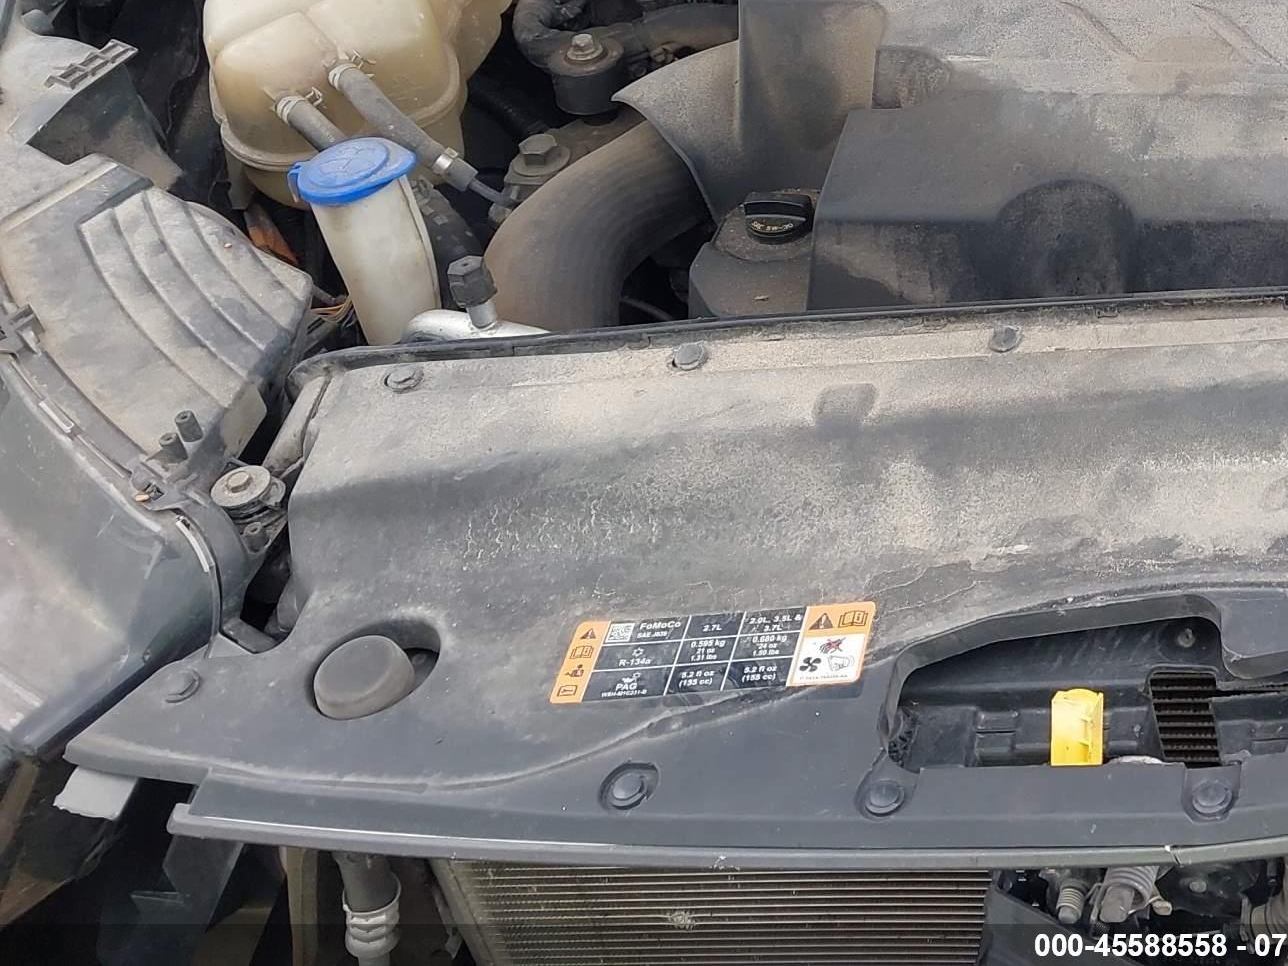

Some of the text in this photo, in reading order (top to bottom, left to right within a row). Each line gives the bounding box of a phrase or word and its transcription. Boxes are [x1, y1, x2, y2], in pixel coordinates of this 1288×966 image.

[774, 614, 792, 623] 3.5L
[794, 613, 803, 622] &
[640, 621, 681, 629] FoMoCo
[702, 624, 722, 632] 2.7L
[763, 623, 783, 632] 3.7L
[691, 639, 726, 648] 0.595 kg
[752, 634, 788, 644] 0.680 kg
[752, 648, 780, 657] 1.50 lbs
[619, 658, 651, 666] R-134a
[690, 653, 718, 662] 1.31 lbs
[681, 671, 695, 679] 5.2
[743, 666, 758, 675] 5.2
[699, 678, 713, 686] cc)
[741, 672, 777, 683] (155 cc)
[616, 683, 637, 691] PAG
